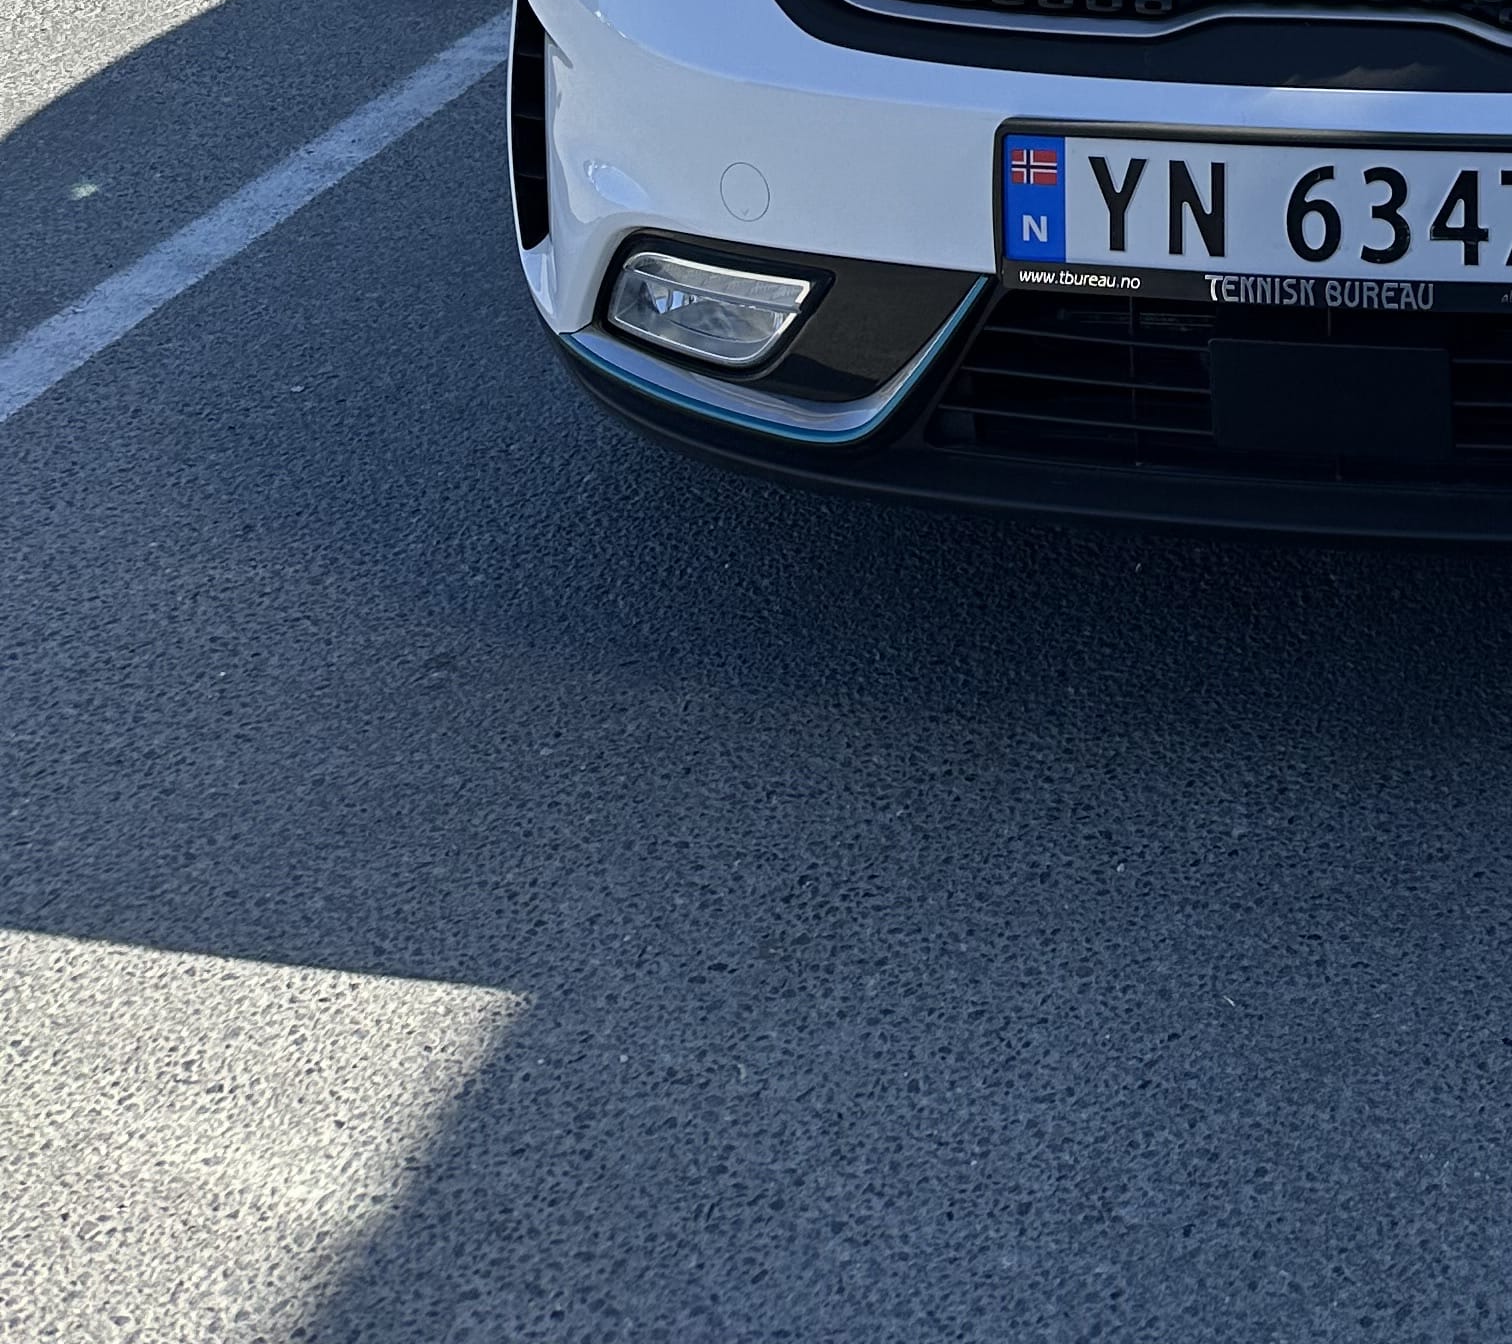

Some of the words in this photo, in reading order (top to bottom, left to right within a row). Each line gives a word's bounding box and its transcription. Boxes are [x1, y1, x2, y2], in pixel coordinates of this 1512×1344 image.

[1087, 156, 1226, 258] YN
[1021, 214, 1048, 243] N
[1018, 269, 1142, 290] www.tbureau.no
[1204, 274, 1316, 306] TEKNISK
[1324, 279, 1434, 310] BUREAU
